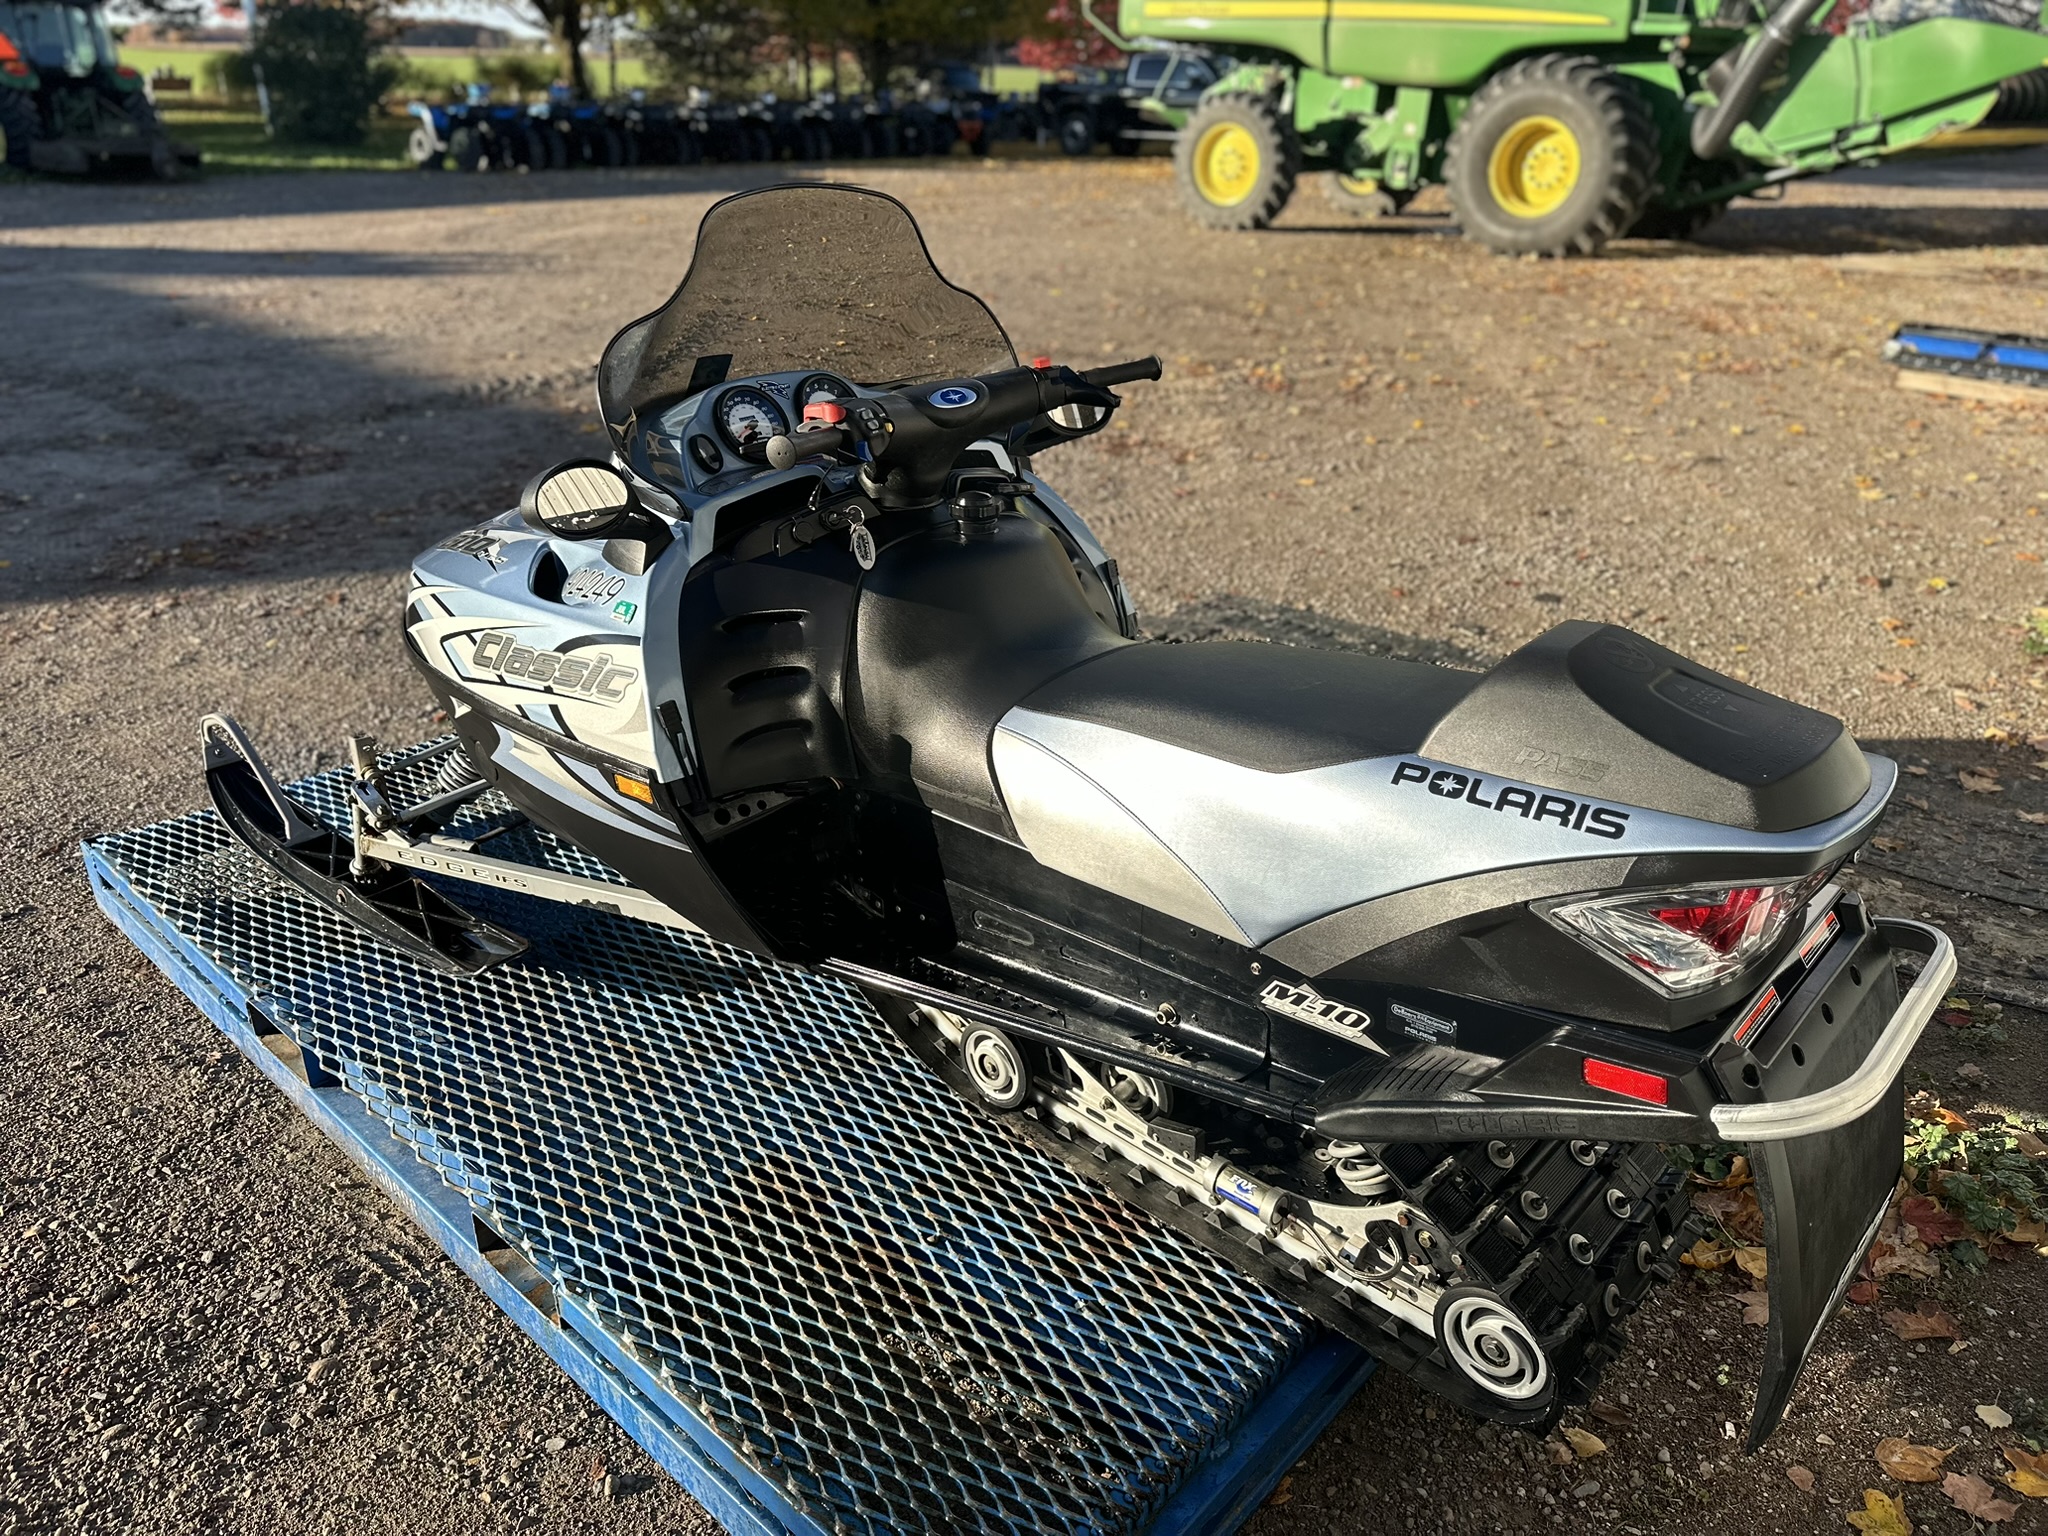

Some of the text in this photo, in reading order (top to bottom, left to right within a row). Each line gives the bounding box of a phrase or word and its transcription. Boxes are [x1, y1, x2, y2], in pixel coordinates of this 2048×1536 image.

[472, 630, 638, 702] Classic
[1391, 761, 1631, 840] POLARIS
[397, 850, 529, 888] EDGE IFS
[1260, 980, 1371, 1030] M-10
[1229, 1174, 1258, 1196] FOX
